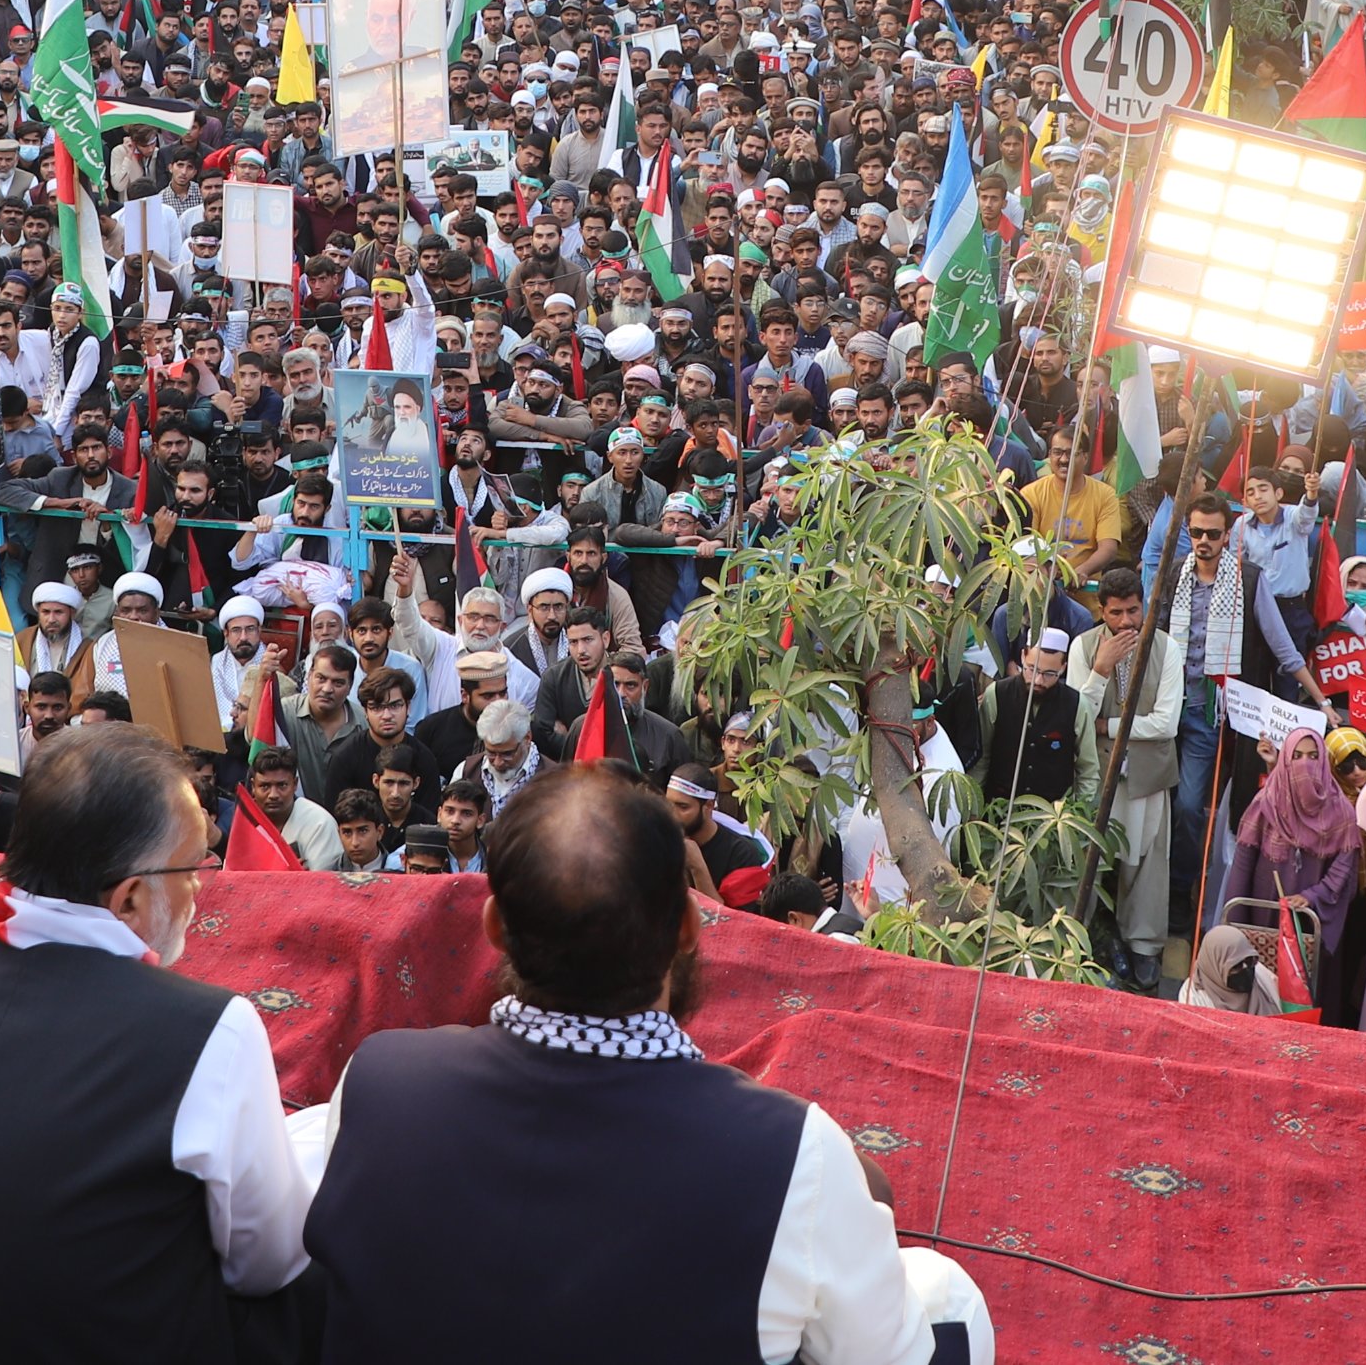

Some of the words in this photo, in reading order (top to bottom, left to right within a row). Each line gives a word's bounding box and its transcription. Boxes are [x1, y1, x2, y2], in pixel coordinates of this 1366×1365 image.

[1084, 14, 1176, 97] 40
[1105, 95, 1153, 119] HTV
[368, 451, 400, 464] حماس
[1320, 661, 1364, 685] FOR
